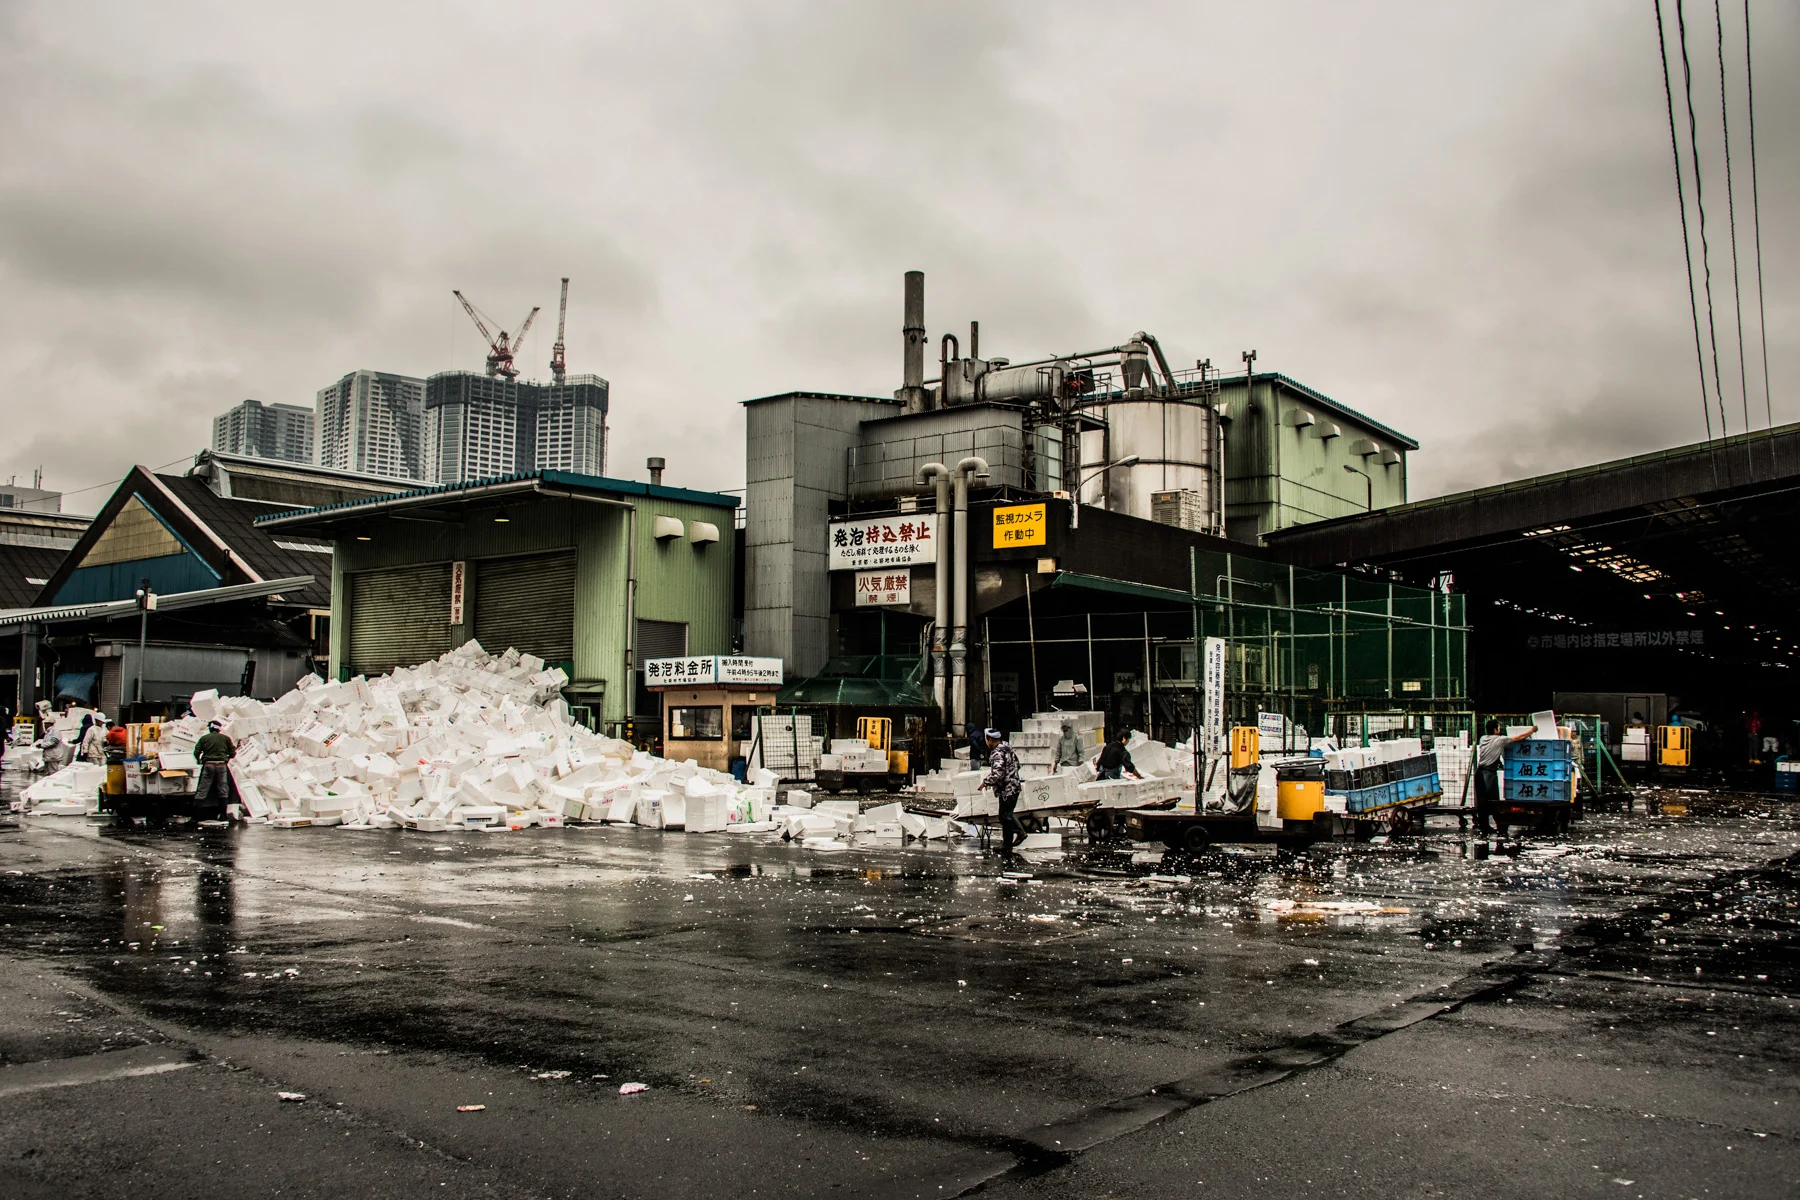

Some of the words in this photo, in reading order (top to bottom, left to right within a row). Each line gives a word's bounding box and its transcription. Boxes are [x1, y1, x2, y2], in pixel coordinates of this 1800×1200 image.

[996, 510, 1043, 525] 監視カメラ
[834, 521, 931, 547] 発泡持込禁止
[1004, 528, 1035, 541] 作動中
[858, 575, 908, 592] 火気厳禁
[1541, 630, 1704, 648] 市場内は指定場所以外禁煙
[648, 659, 713, 677] 発泡料金所
[1517, 762, 1548, 777] 佃友
